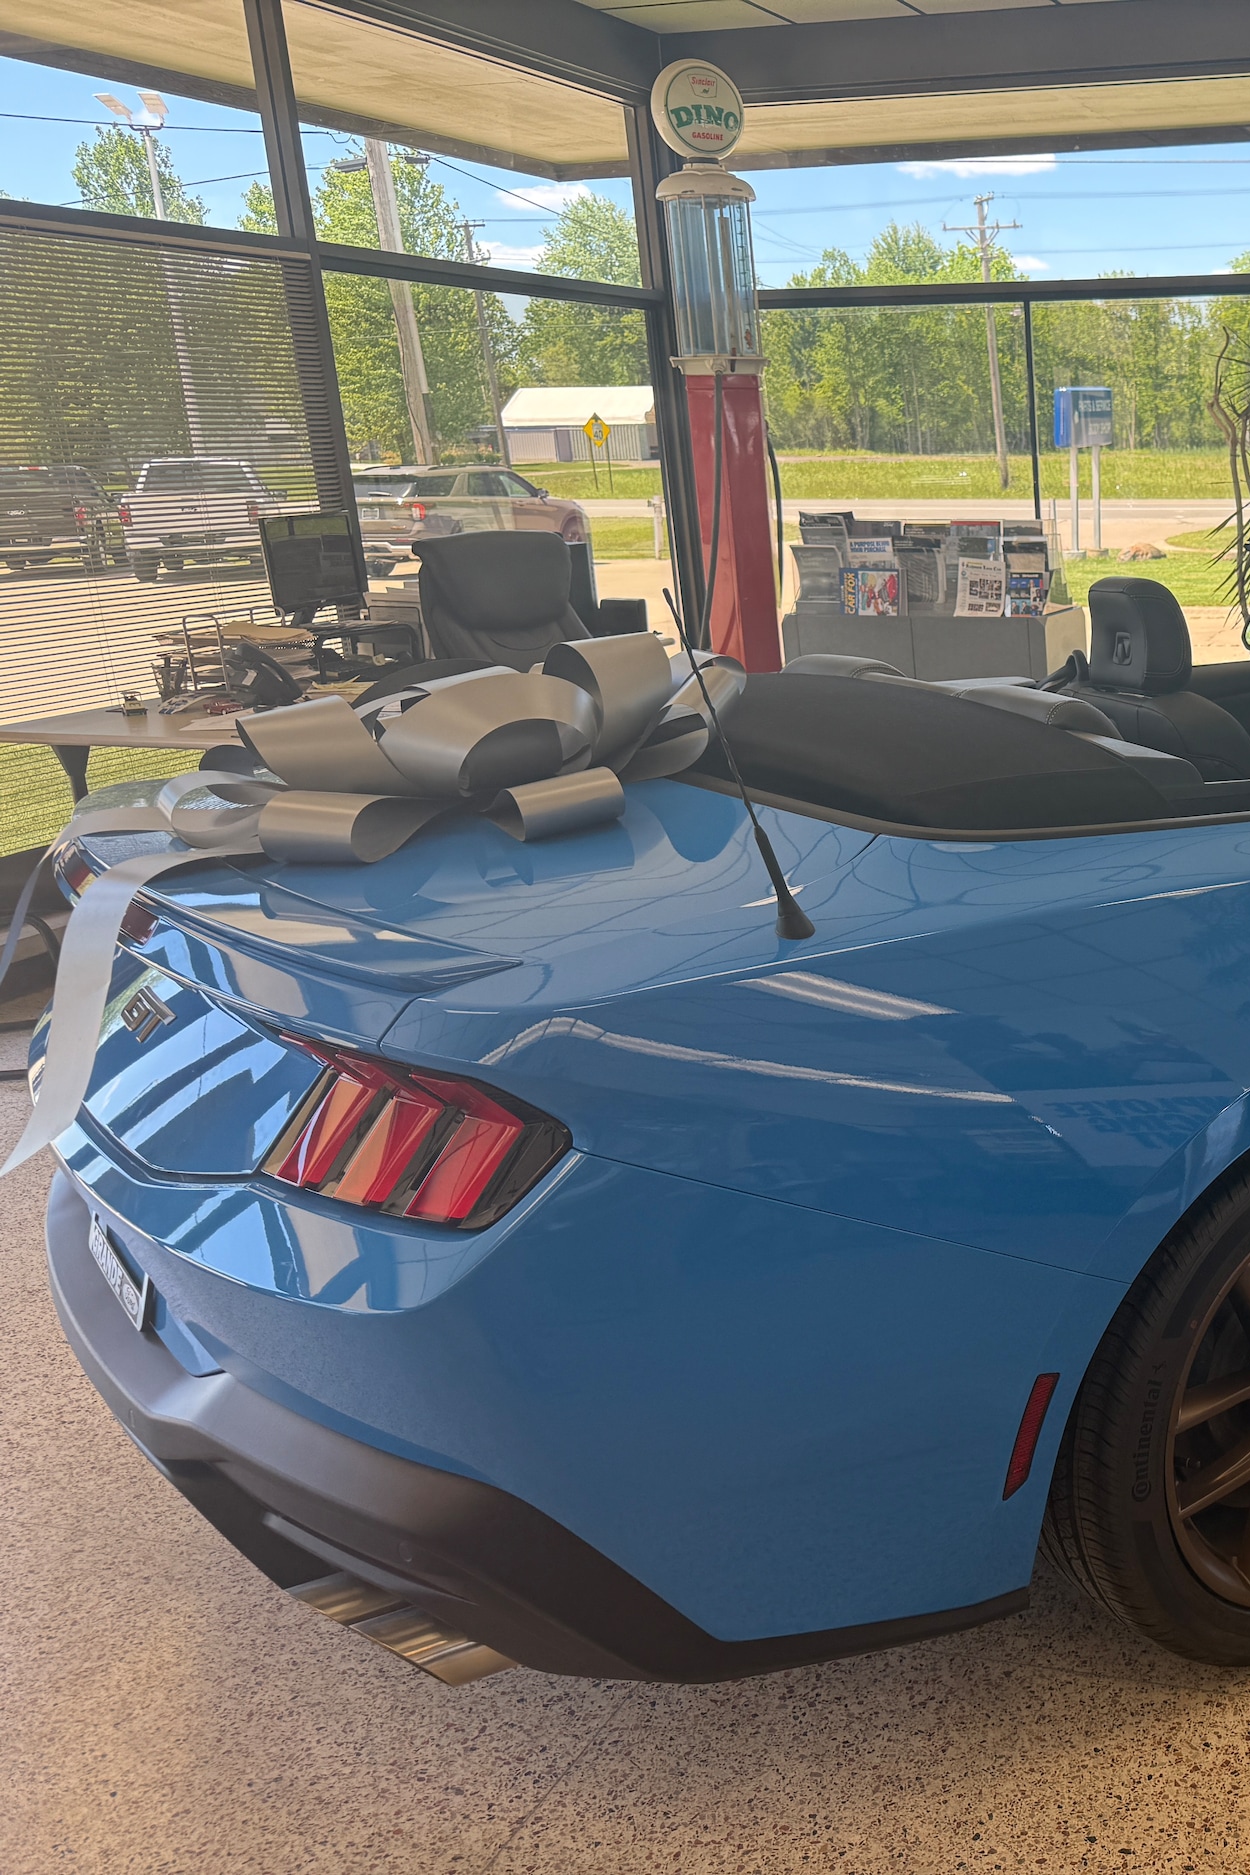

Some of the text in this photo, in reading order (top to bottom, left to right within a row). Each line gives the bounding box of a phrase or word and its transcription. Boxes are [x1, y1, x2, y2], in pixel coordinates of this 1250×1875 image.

[691, 76, 716, 87] Sinclair
[670, 104, 739, 132] DINO
[692, 132, 724, 141] GASOLINE
[593, 430, 604, 440] 40
[847, 573, 856, 614] CAR FOX
[121, 985, 177, 1043] GT
[91, 1226, 123, 1297] GRANDE
[1131, 1380, 1163, 1502] Continental
